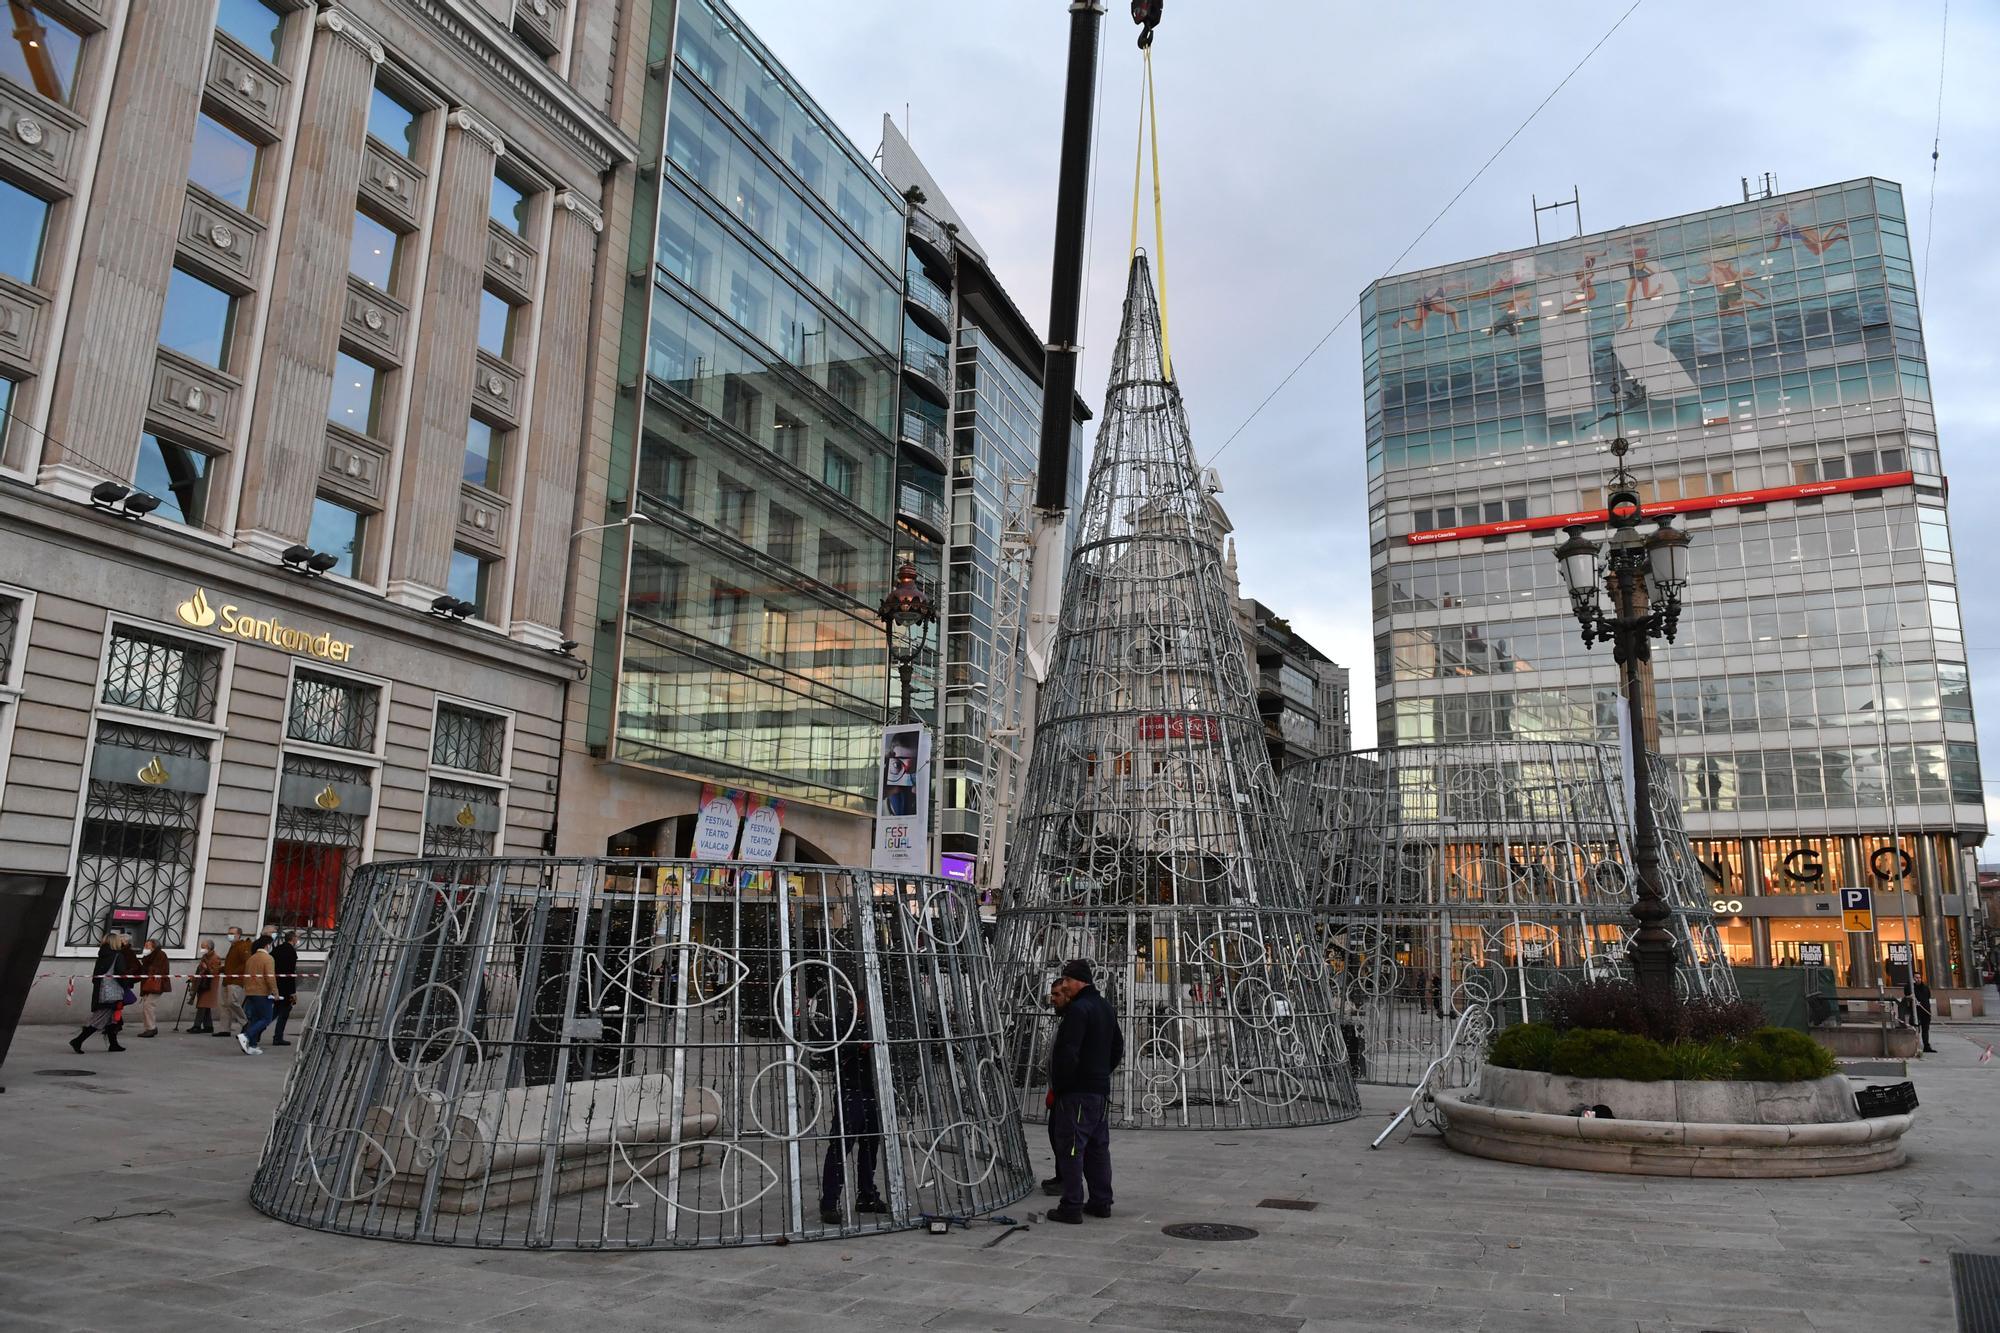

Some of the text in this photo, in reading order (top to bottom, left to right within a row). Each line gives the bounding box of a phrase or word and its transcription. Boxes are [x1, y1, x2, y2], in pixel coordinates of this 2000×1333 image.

[219, 604, 354, 663] Santander
[705, 815, 733, 828] FESTIVAL
[705, 828, 729, 840] TEATRO
[750, 823, 775, 836] FESTIVAL
[885, 826, 909, 838] FEST
[700, 840, 729, 852] VALACAR
[750, 835, 772, 847] TEATRO
[884, 837, 912, 849] IGUAL
[745, 847, 772, 858] VALACAR
[1847, 890, 1863, 908] P
[1801, 945, 1822, 954] BLACK
[1801, 953, 1823, 961] FRIDAY
